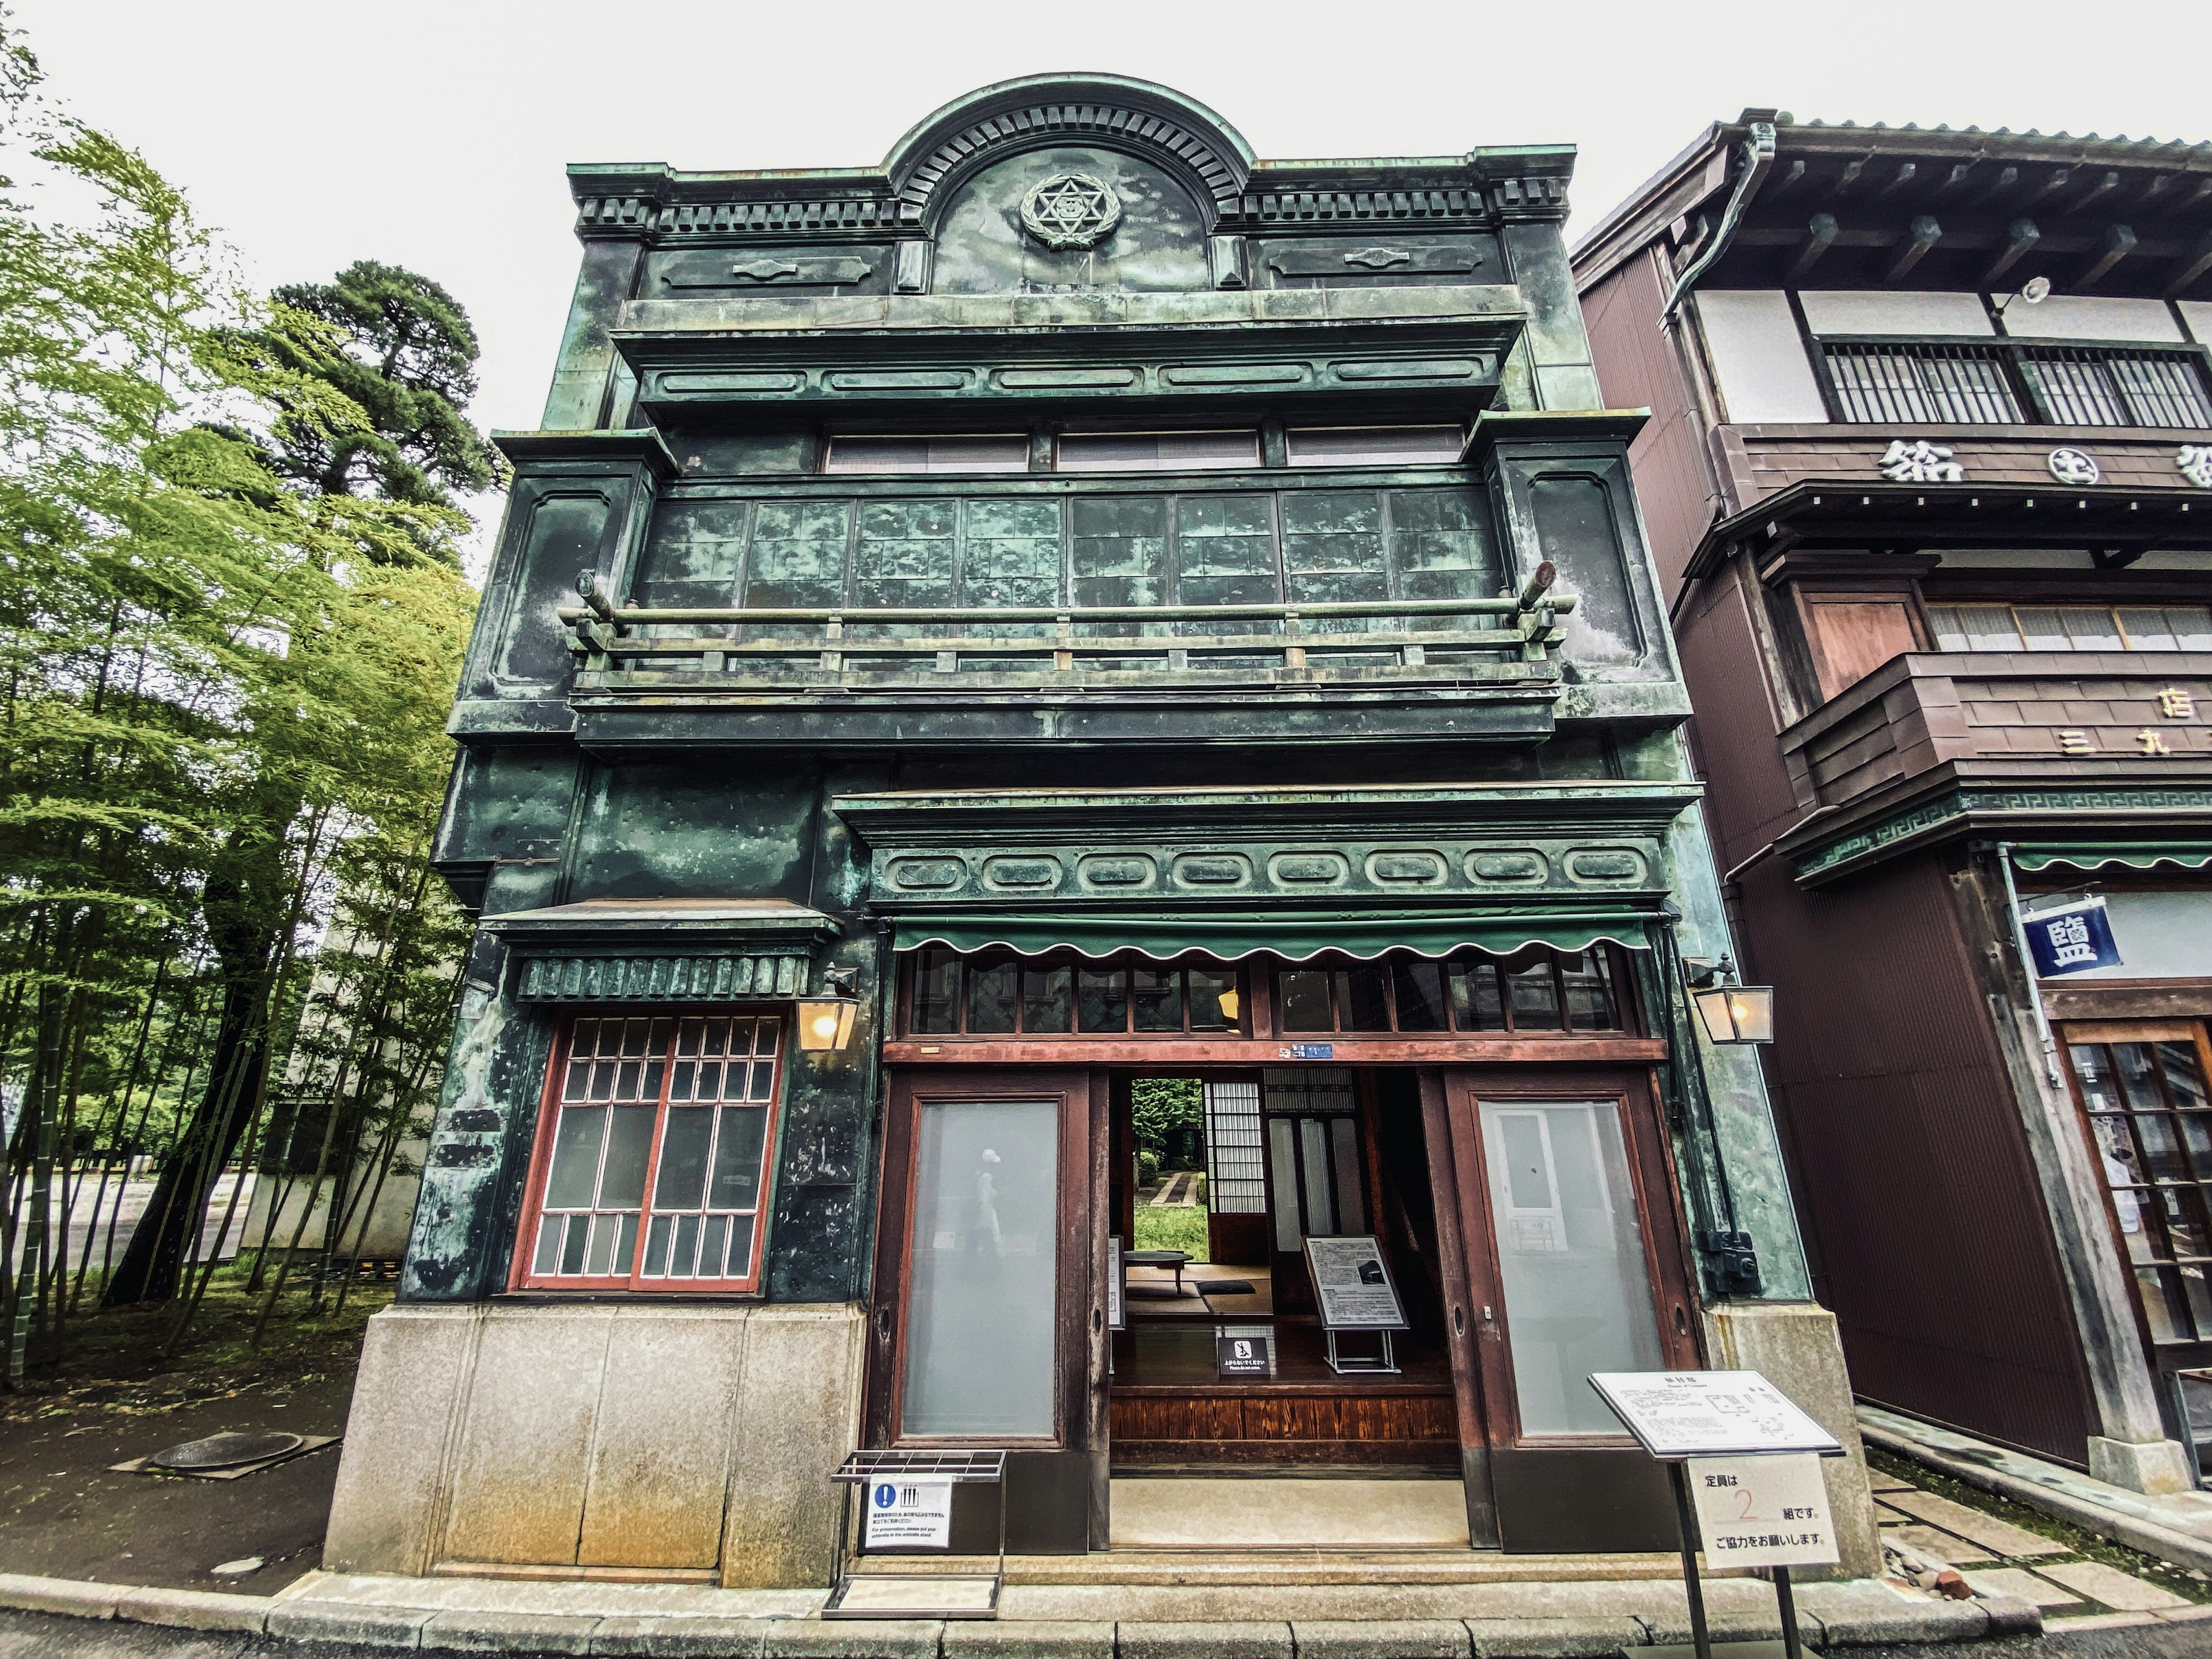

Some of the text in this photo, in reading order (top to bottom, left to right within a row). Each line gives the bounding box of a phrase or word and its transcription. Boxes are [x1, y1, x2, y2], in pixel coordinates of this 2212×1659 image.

[1705, 1475, 1737, 1487] 定員は
[1735, 1489, 1756, 1520] 2
[1783, 1508, 1819, 1520] 組です。
[1716, 1533, 1824, 1549] ご協力をお願いします。
